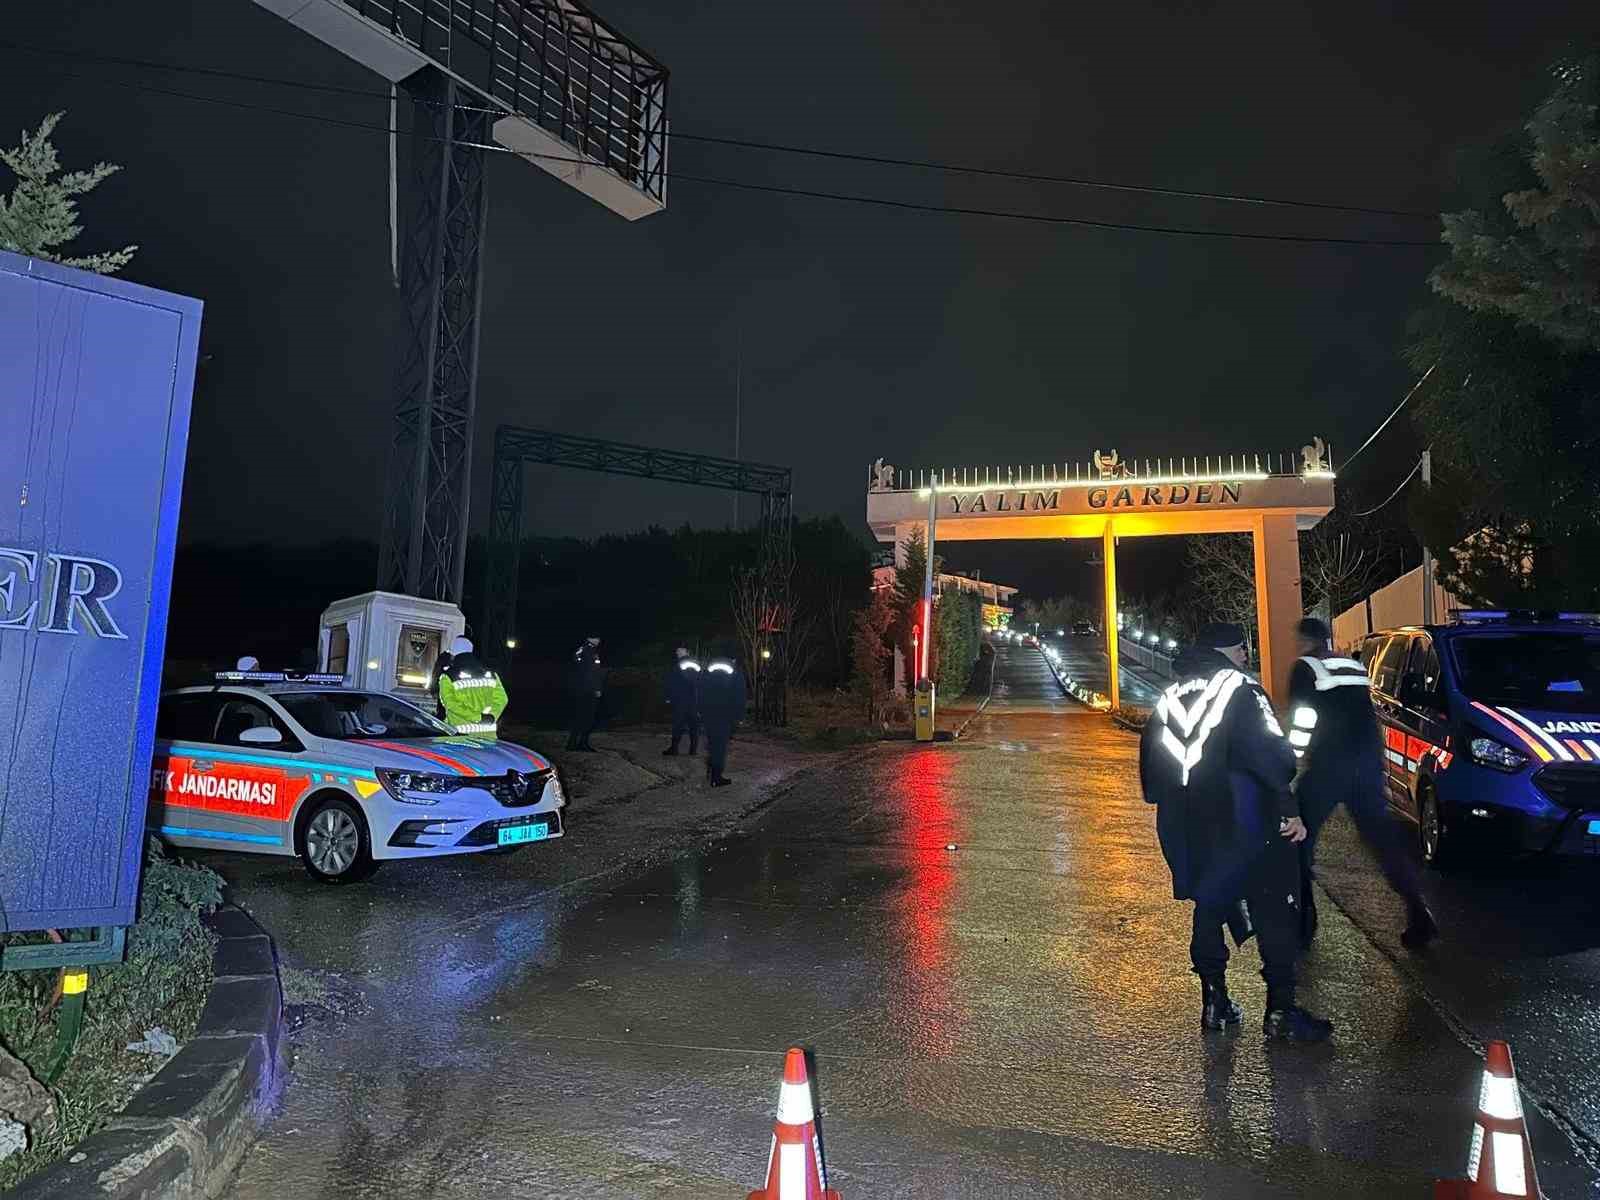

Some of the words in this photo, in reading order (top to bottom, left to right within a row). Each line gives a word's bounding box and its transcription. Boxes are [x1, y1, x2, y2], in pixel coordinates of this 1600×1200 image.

[950, 489, 1061, 513] YALIM
[1087, 482, 1242, 509] GARDEN
[179, 773, 277, 805] JANDARMASI
